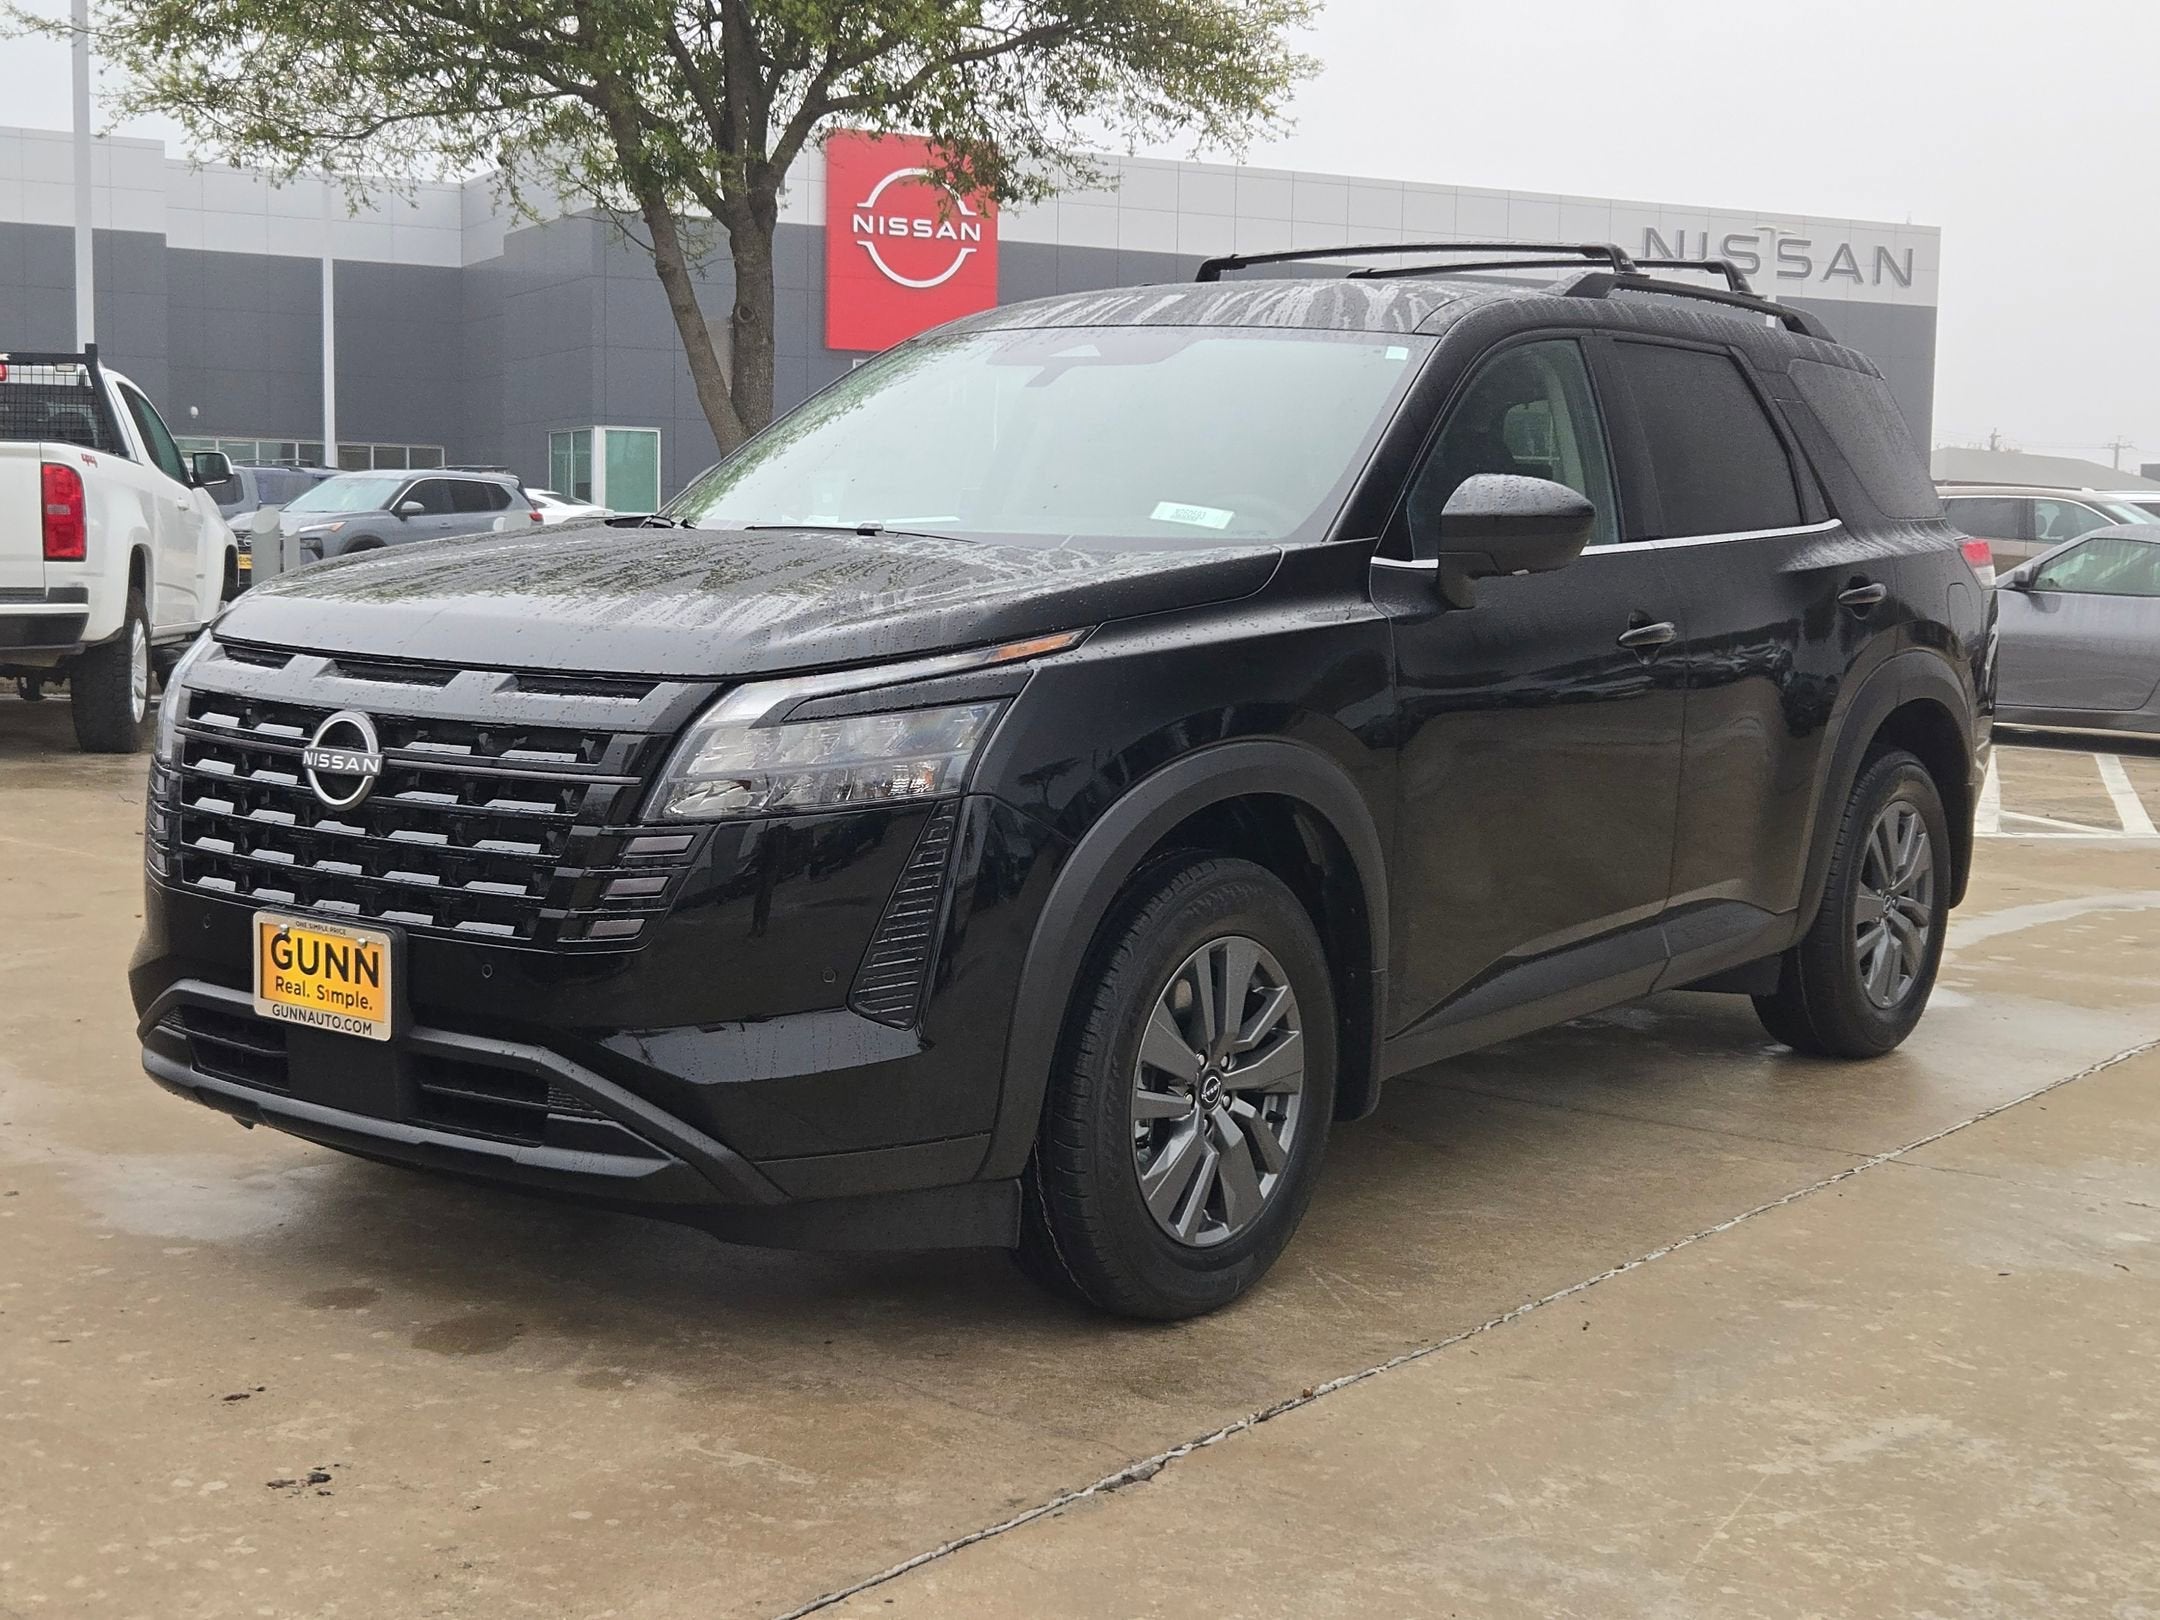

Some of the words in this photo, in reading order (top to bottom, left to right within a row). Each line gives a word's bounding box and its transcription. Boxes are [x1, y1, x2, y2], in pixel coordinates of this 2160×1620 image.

[853, 214, 981, 241] NISSAN
[1643, 226, 1913, 288] NISSAN
[303, 750, 379, 773] NISSAN
[271, 932, 379, 988] GUNN
[275, 976, 310, 998] Real.
[272, 1003, 372, 1036] GUNNAUTO.COM
